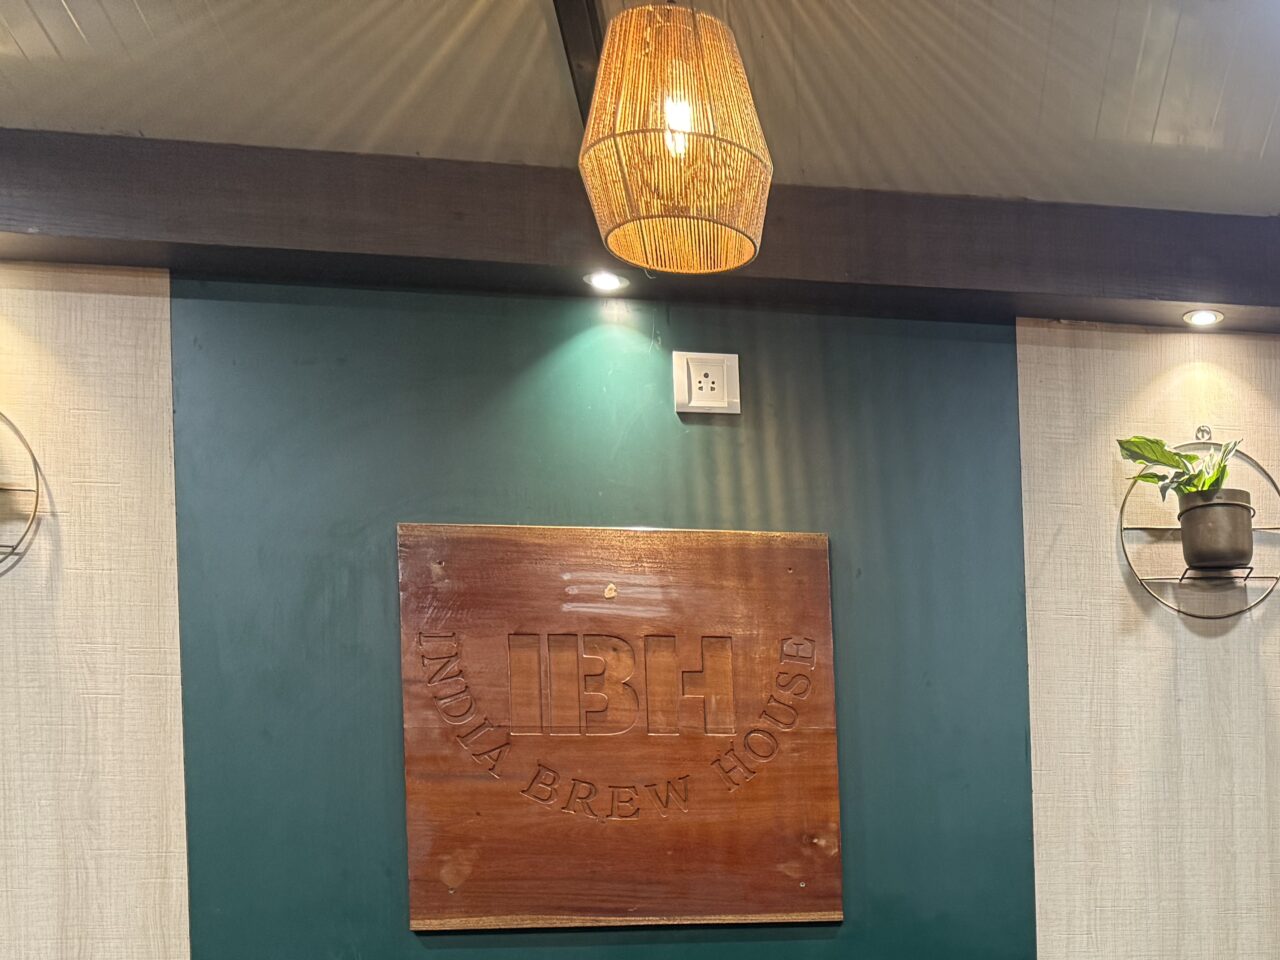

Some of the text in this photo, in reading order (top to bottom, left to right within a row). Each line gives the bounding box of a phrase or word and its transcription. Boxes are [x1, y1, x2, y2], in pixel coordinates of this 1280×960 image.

[418, 631, 817, 821] INDIA BREW HOUSE
[508, 633, 736, 736] IBH
